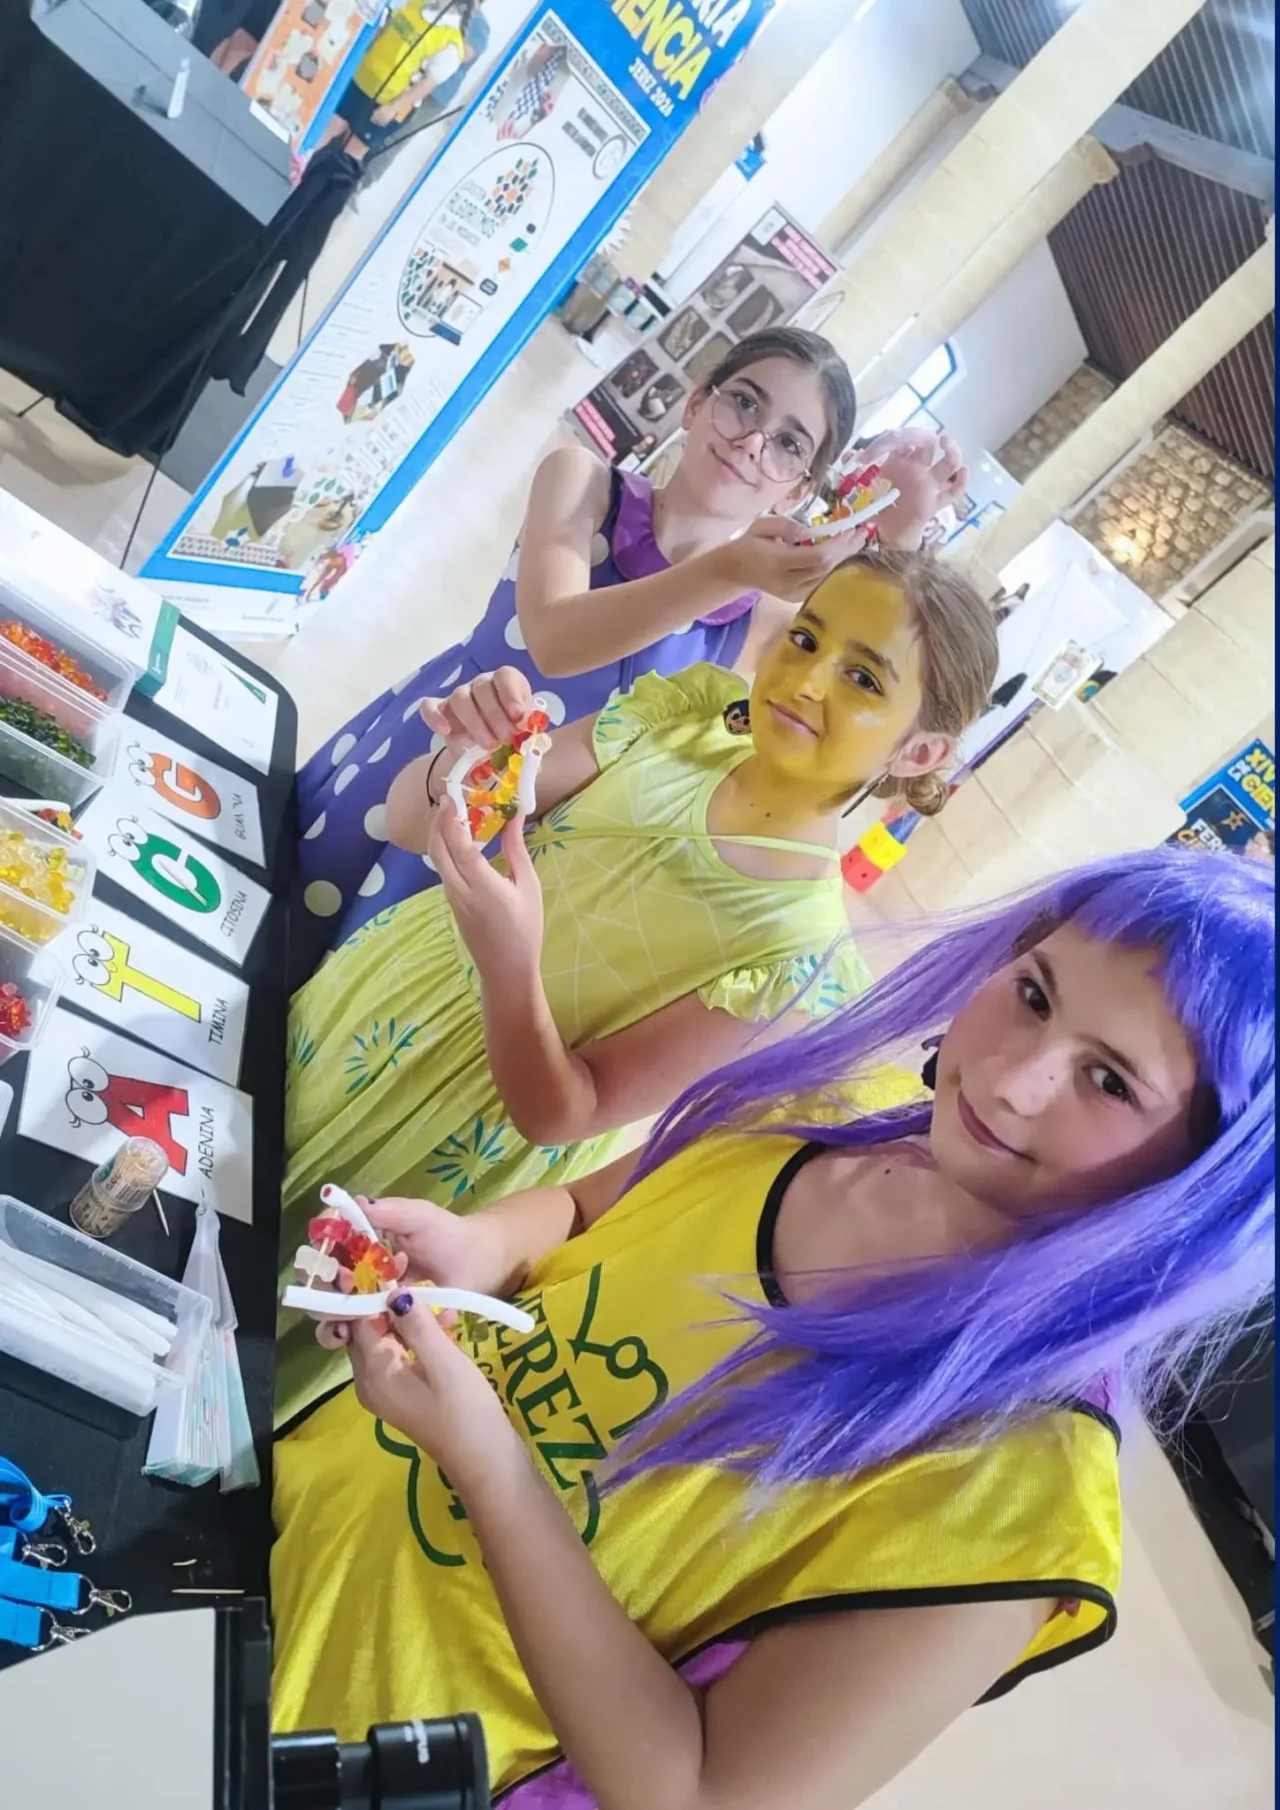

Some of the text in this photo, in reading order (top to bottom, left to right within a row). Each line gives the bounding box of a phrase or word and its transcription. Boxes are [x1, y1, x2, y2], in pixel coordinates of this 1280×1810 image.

[150, 753, 222, 820] G
[129, 832, 222, 914] C
[220, 890, 248, 937] CITOSINA
[90, 931, 202, 1024] T
[208, 997, 229, 1046] TIMINA
[99, 1074, 190, 1176] A
[199, 1104, 216, 1180] ADENINA
